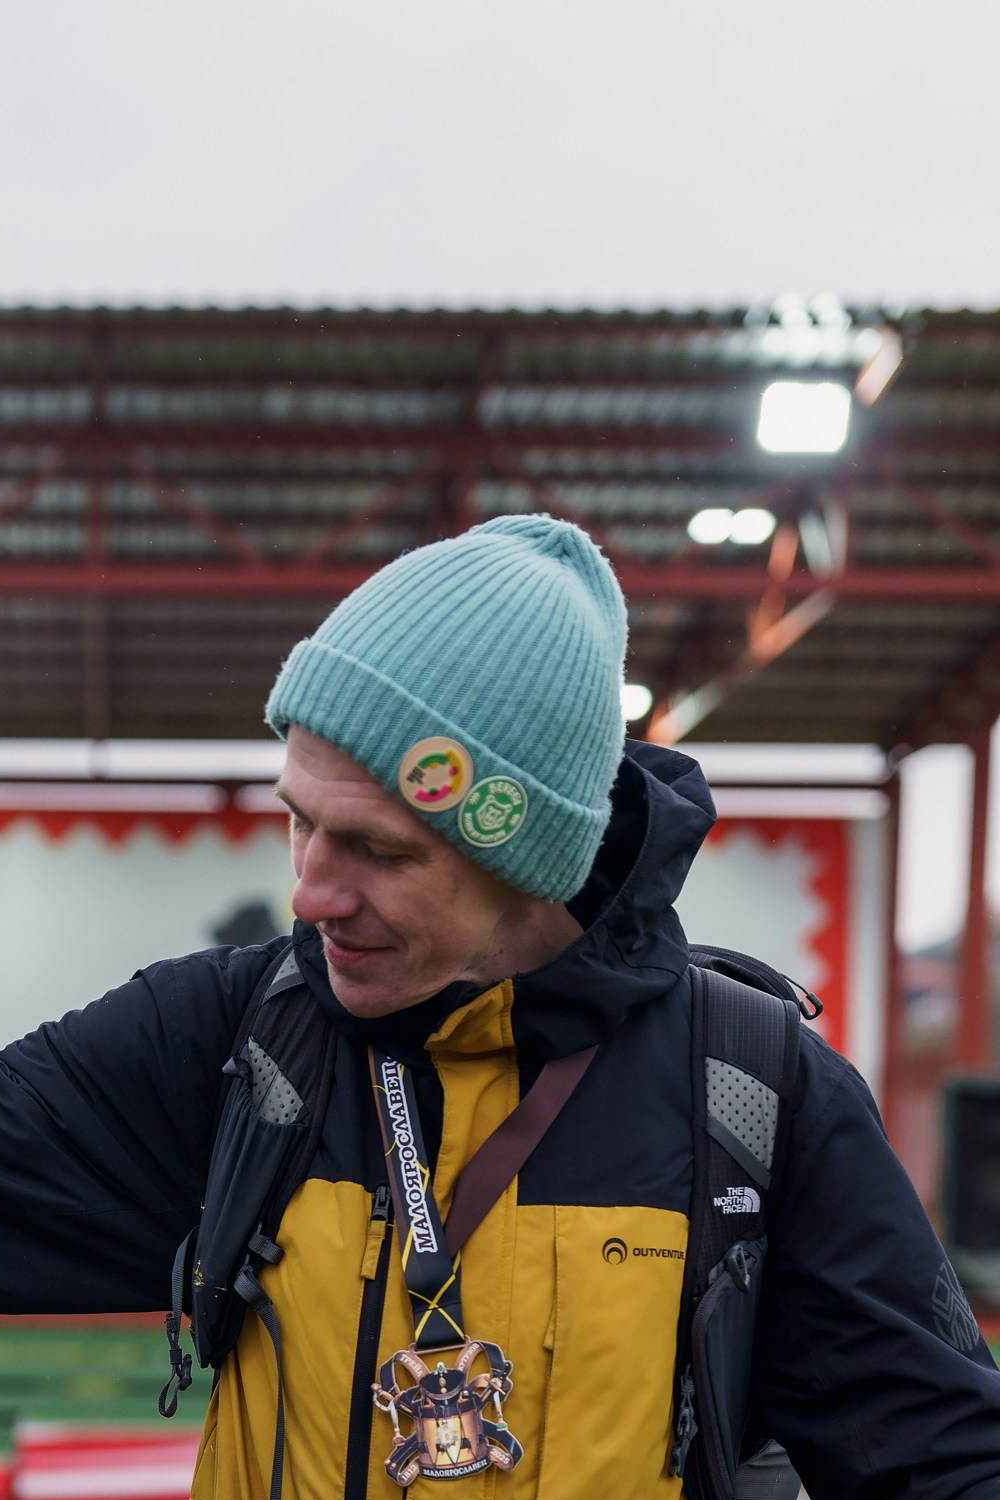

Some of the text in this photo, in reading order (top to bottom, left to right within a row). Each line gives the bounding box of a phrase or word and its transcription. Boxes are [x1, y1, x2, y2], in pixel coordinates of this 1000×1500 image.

[726, 1186, 744, 1196] THE
[713, 1195, 743, 1207] NORTH
[722, 1204, 743, 1214] FACE
[400, 1353, 423, 1378] ТРЕЙЛ
[492, 1447, 511, 1465] 2025
[401, 1463, 418, 1481] 1812
